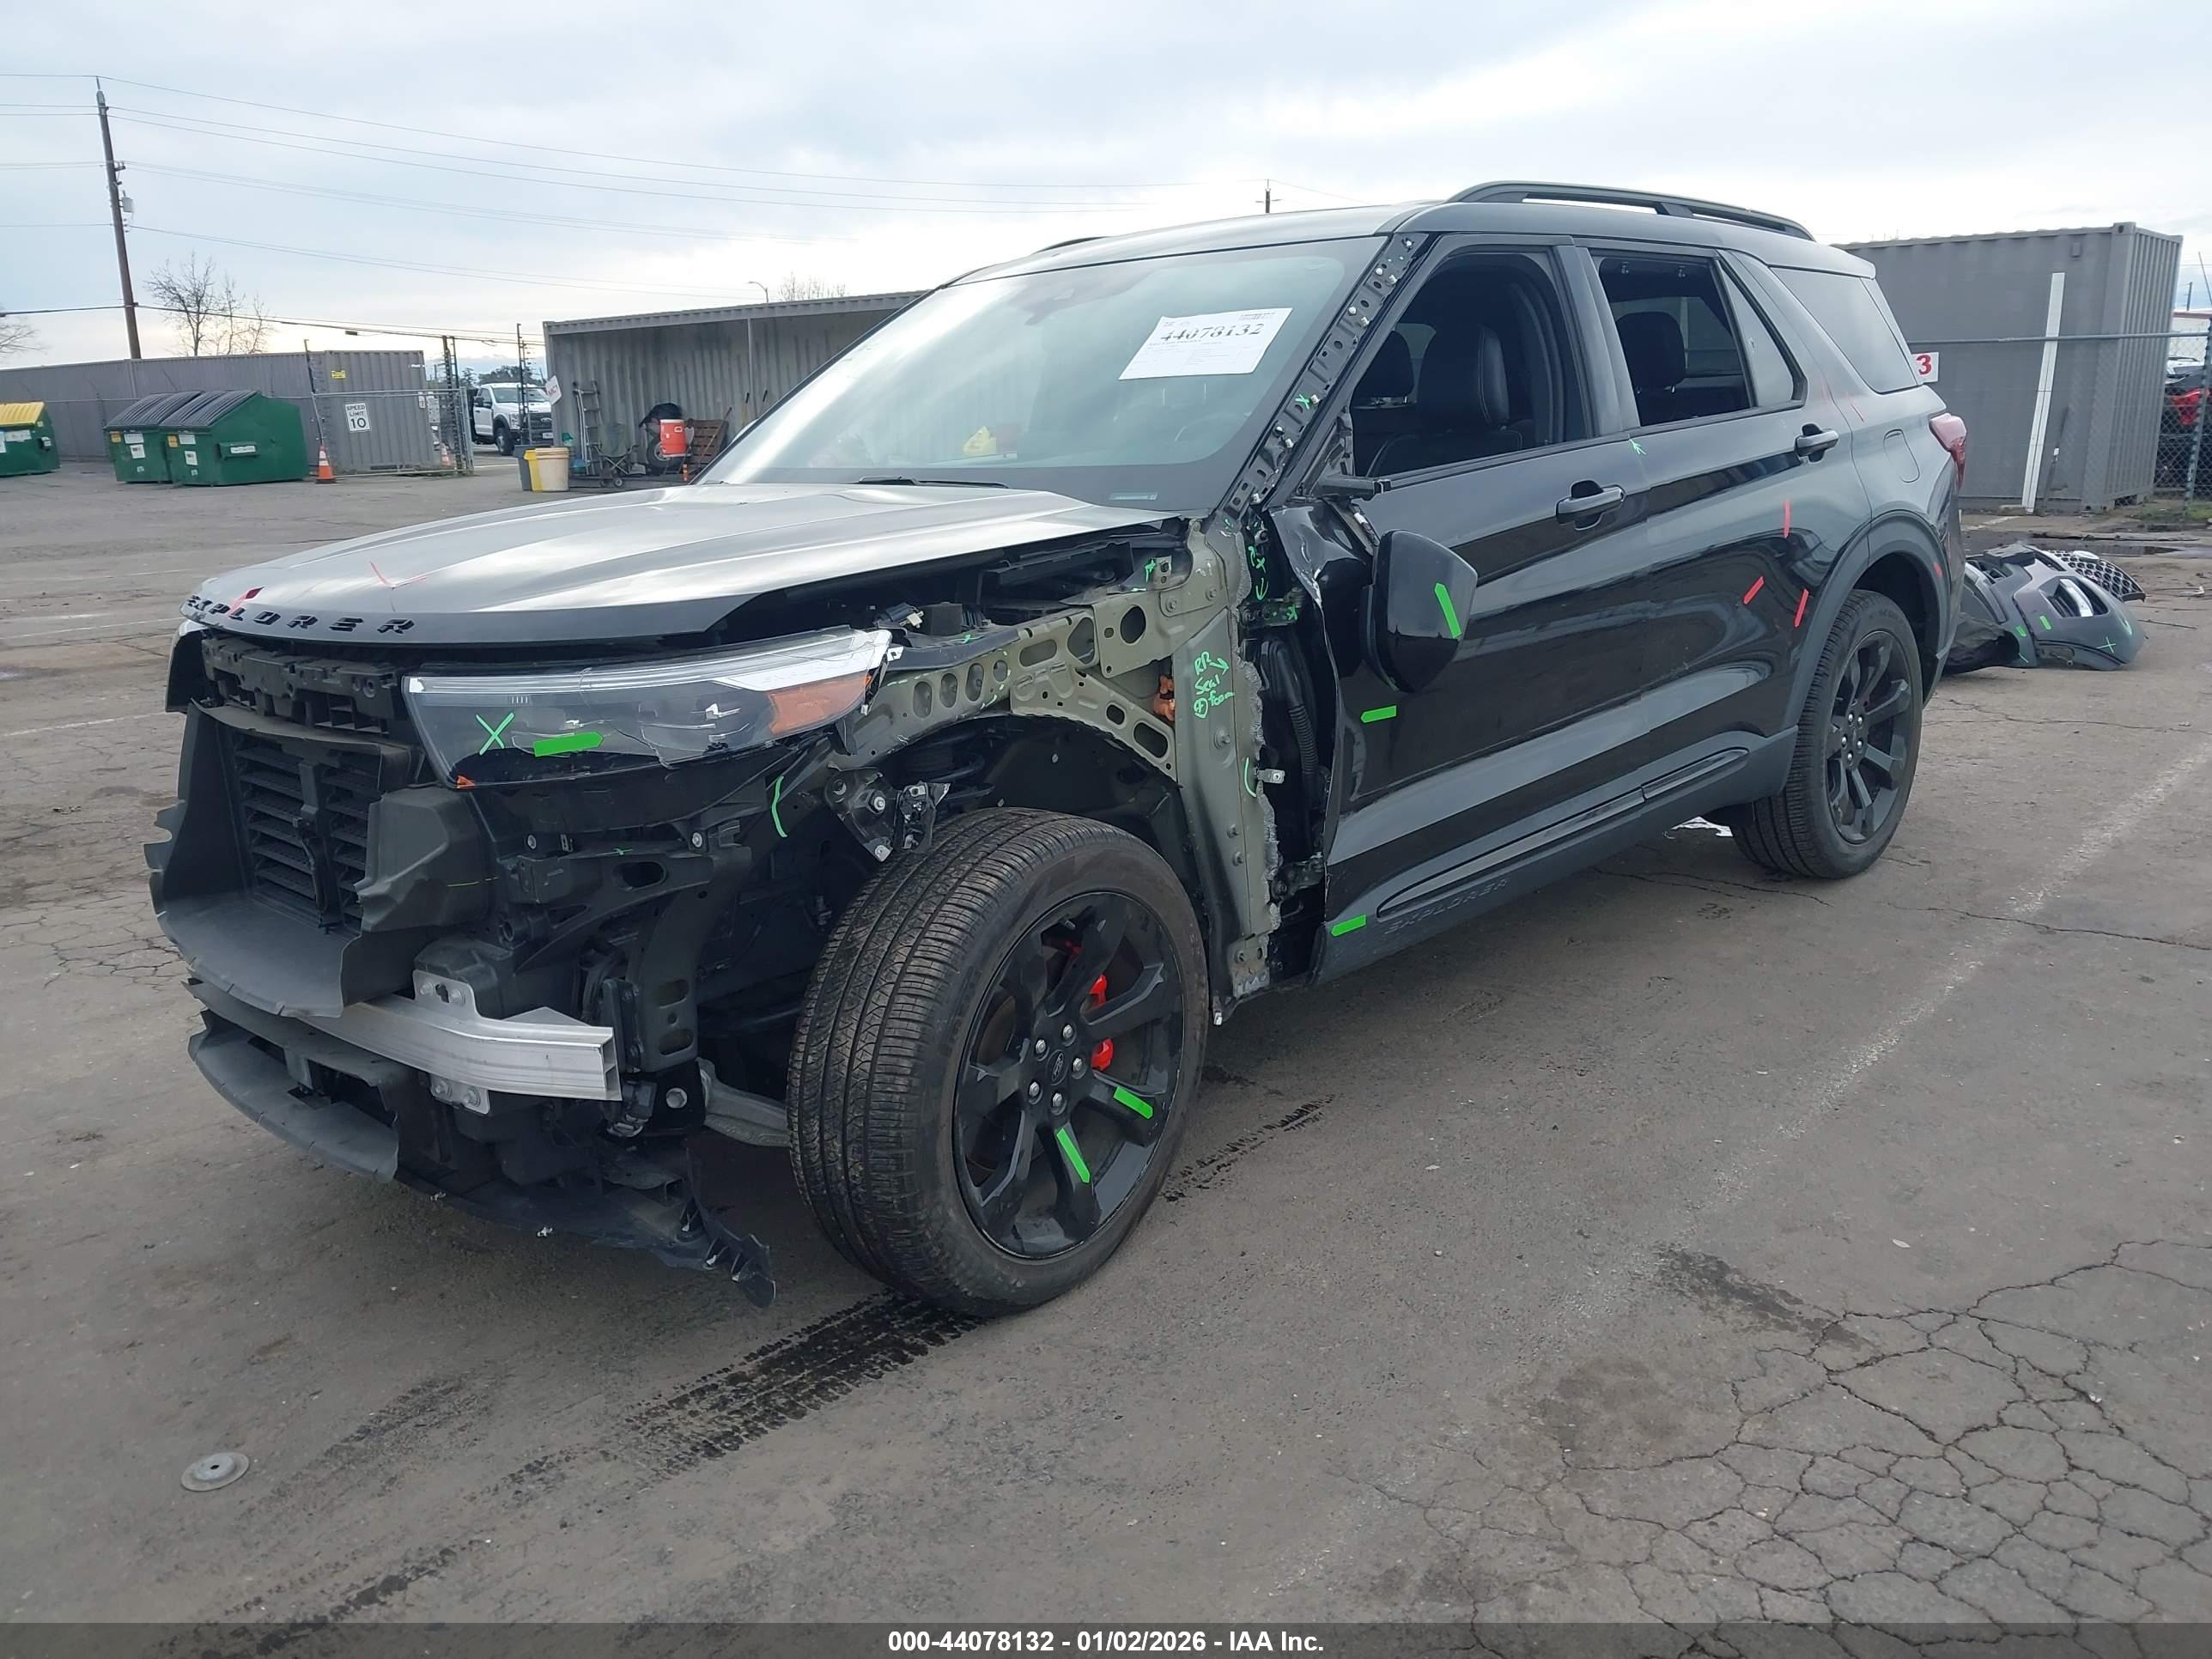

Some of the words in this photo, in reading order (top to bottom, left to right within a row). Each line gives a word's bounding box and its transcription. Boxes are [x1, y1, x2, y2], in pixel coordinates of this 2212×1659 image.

[1160, 323, 1265, 342] 44078132
[1916, 355, 1932, 375] 3
[351, 417, 367, 428] 10
[186, 594, 416, 635] EXPLORER
[1384, 878, 1508, 935] EXPLORER
